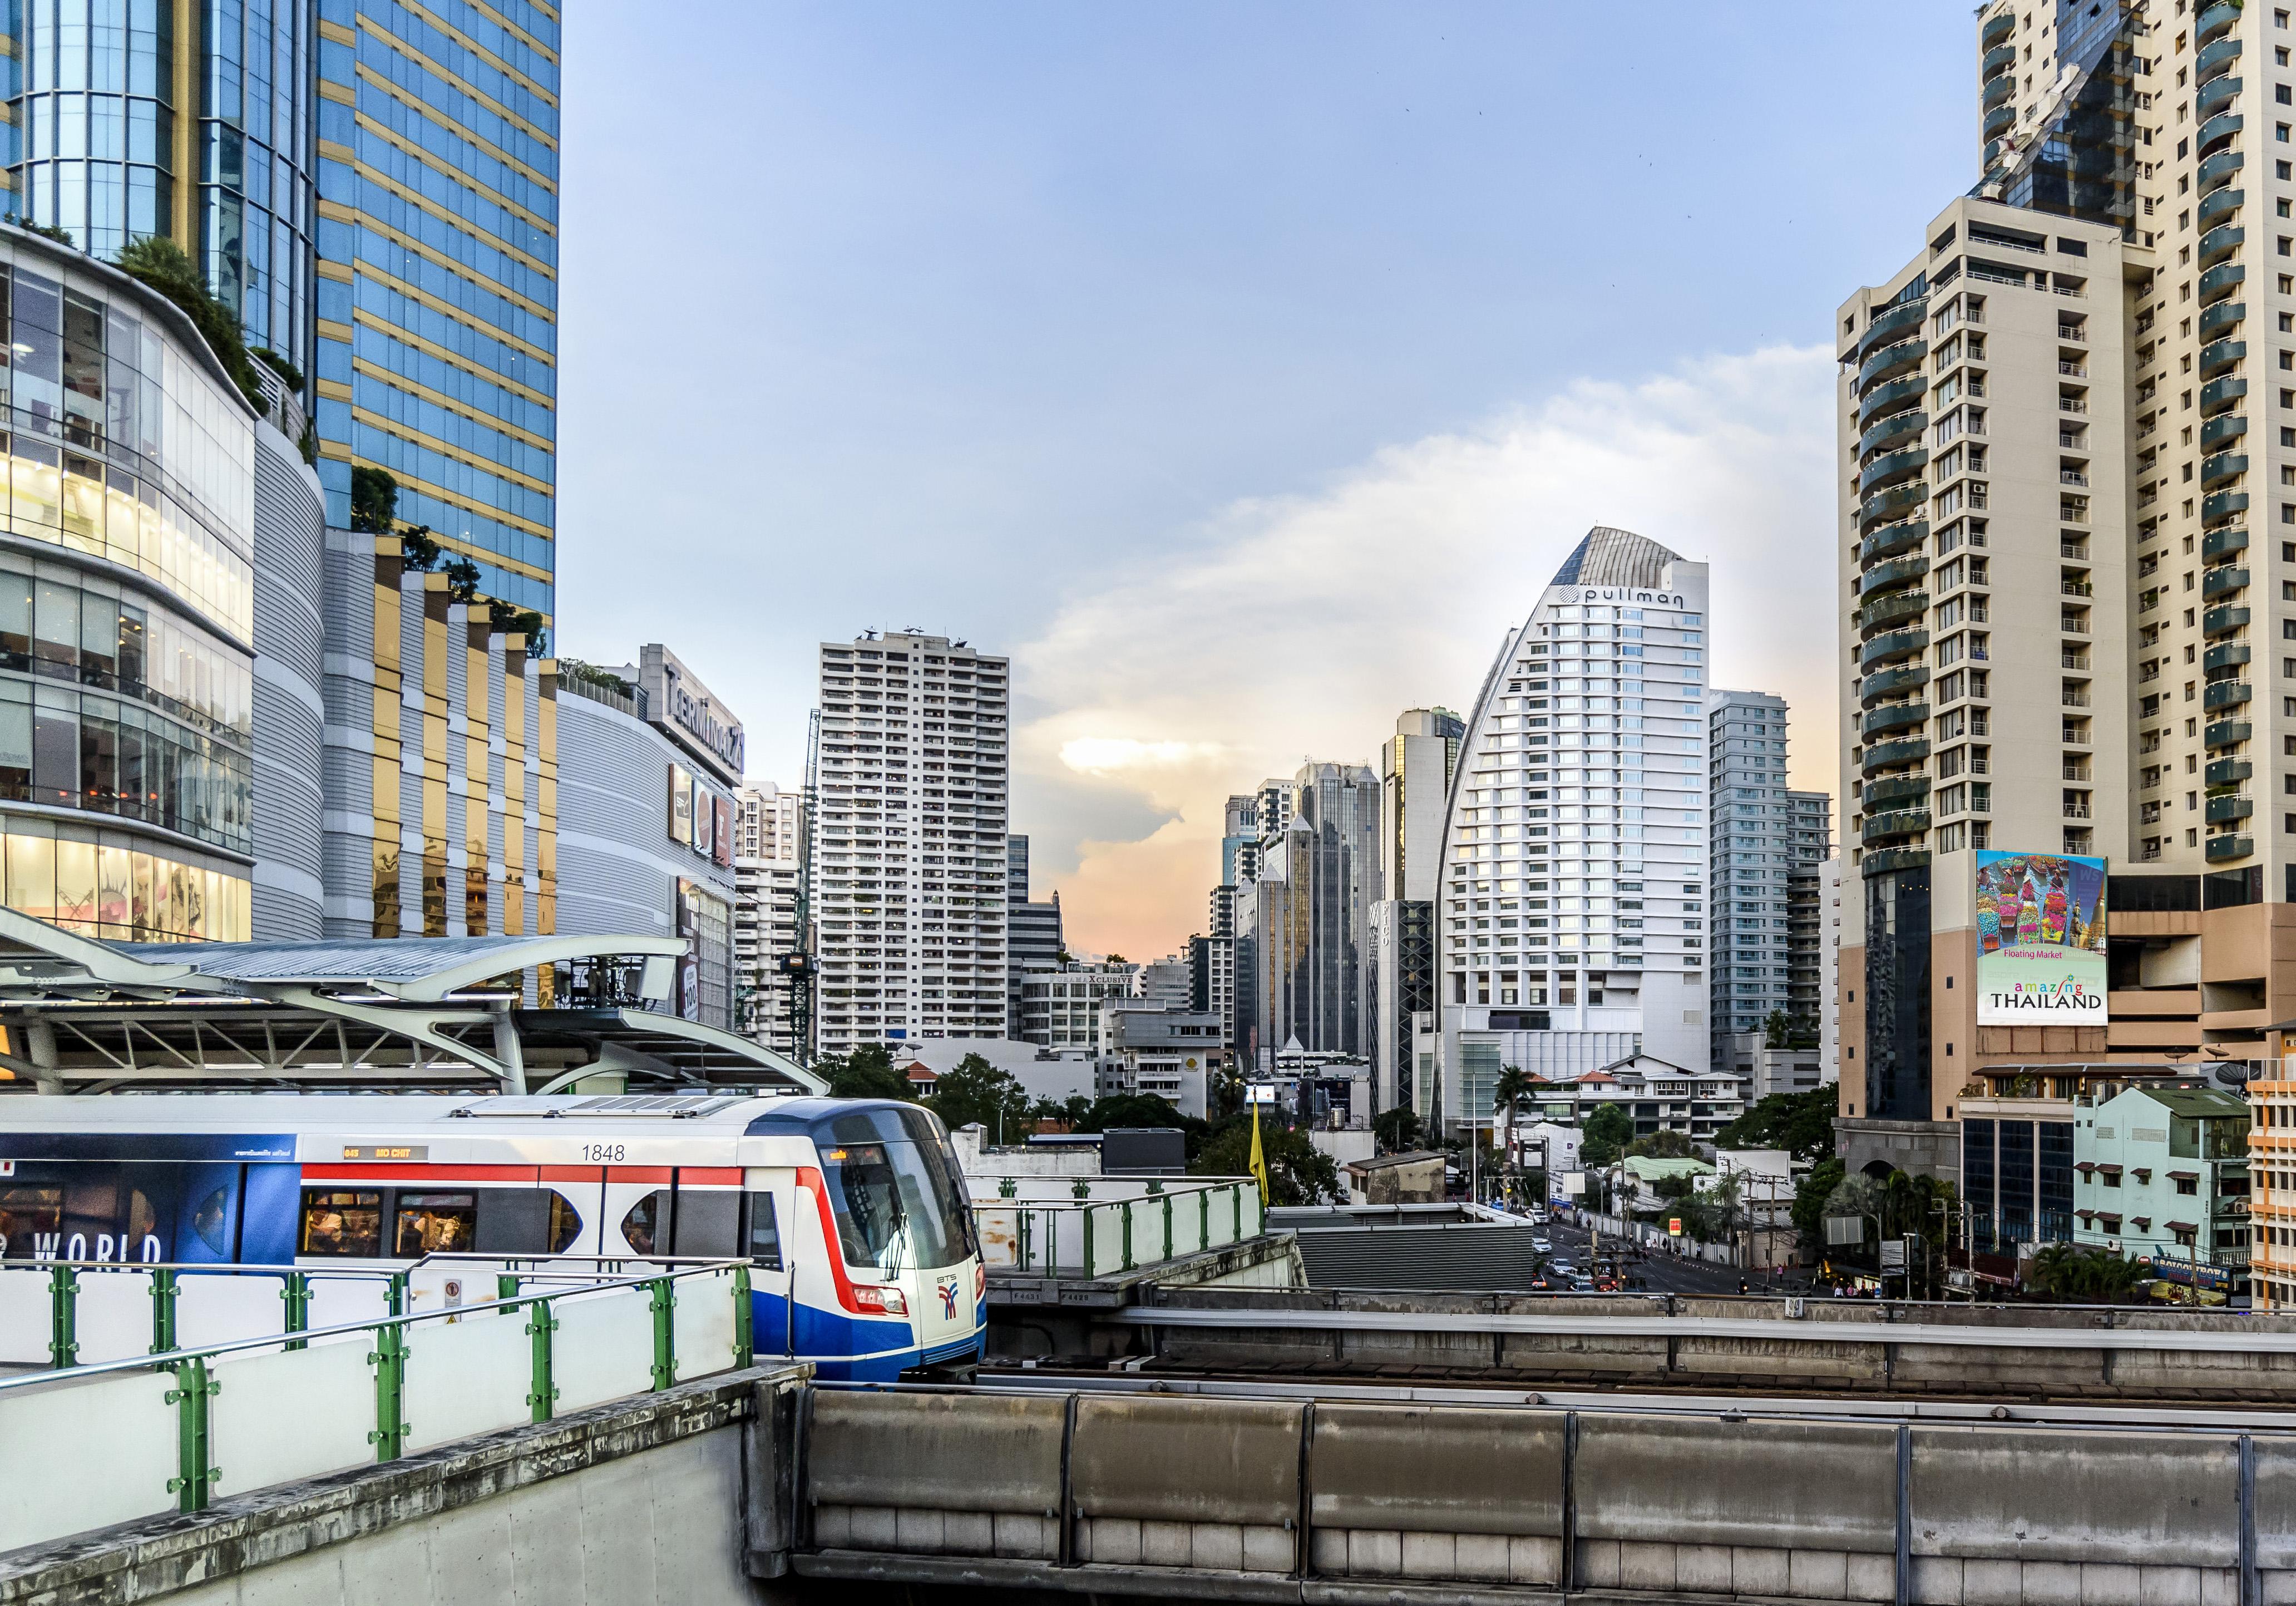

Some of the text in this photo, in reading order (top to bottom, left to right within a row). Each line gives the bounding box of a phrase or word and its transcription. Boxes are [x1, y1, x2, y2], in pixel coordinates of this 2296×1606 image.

[1585, 588, 1683, 609] pullman
[2004, 949, 2035, 960] Floating
[2036, 950, 2062, 959] Market
[2014, 978, 2082, 998] amazing
[1990, 993, 2101, 1009] THAILAND
[391, 1148, 411, 1157] CHIT
[582, 1144, 624, 1161] 1848
[34, 1232, 161, 1273] WORLD
[937, 1273, 957, 1284] BTS
